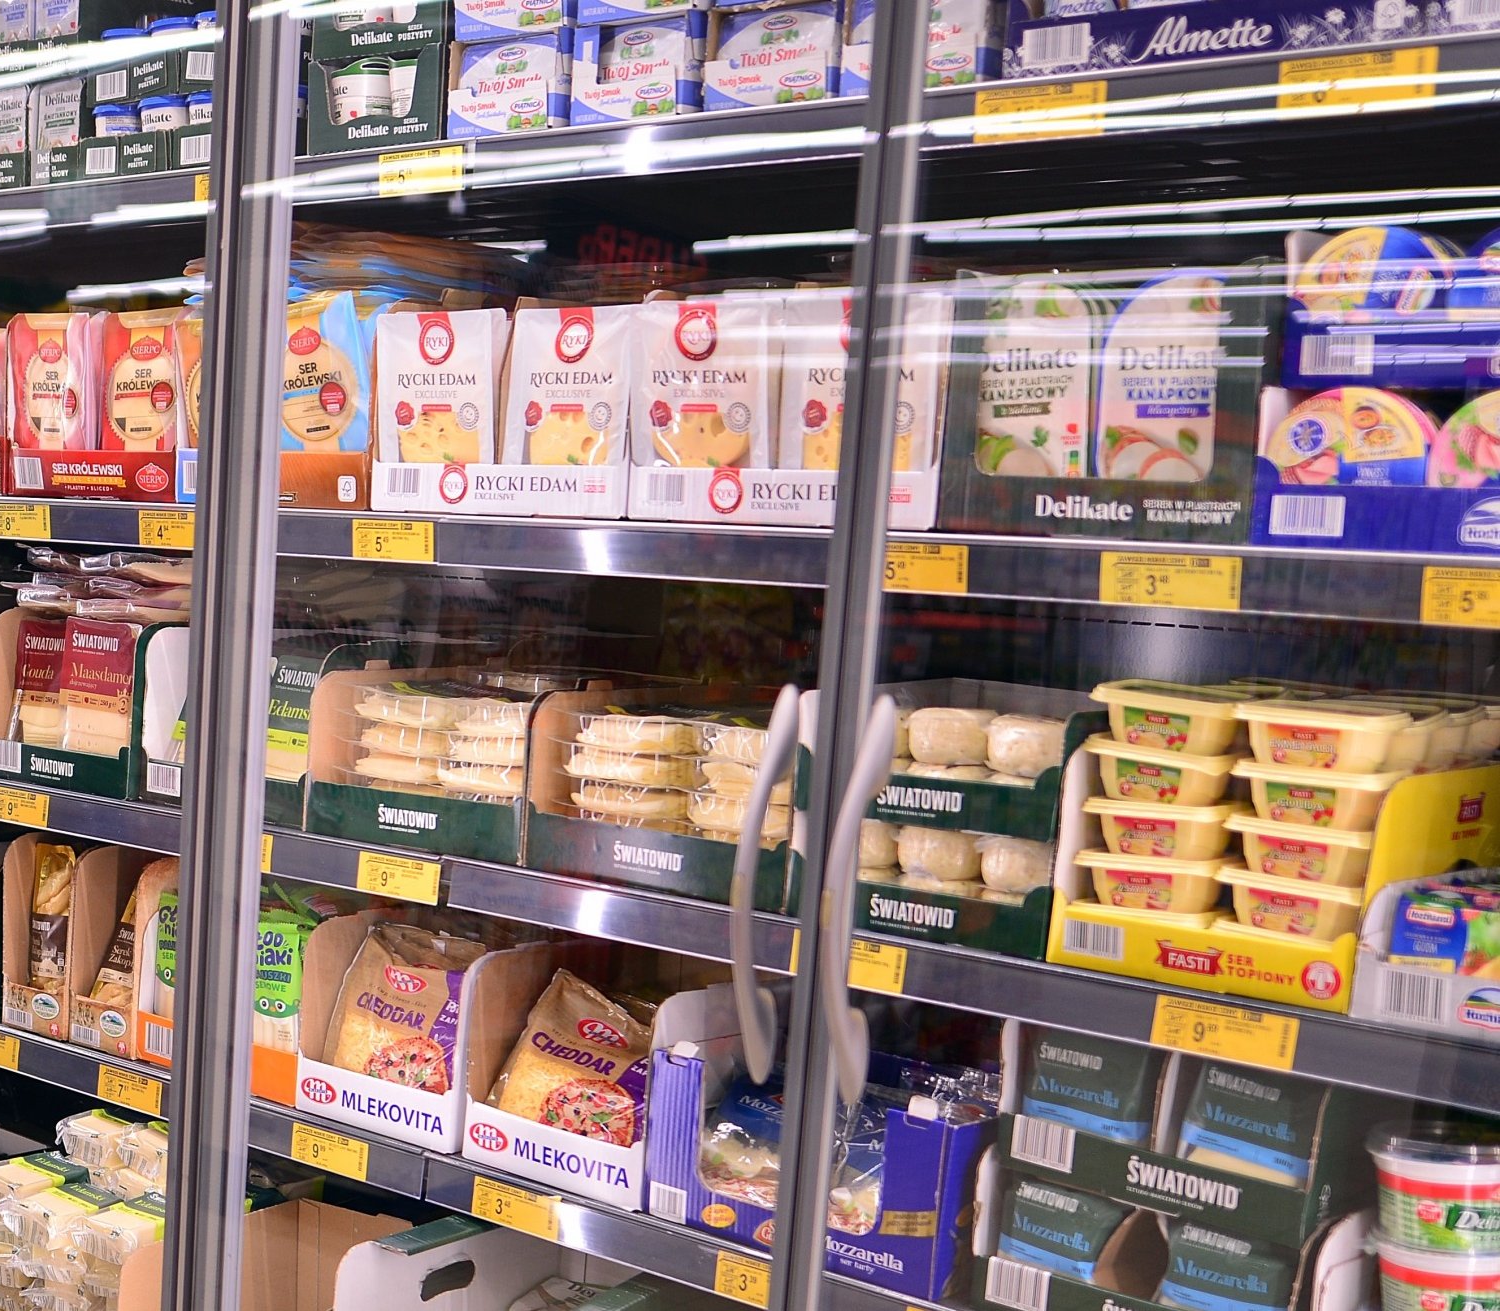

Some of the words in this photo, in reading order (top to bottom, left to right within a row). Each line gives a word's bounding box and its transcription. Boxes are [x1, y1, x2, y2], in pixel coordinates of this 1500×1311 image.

[351, 31, 393, 46] Delikate
[398, 30, 433, 41] PUSZYSTY
[1130, 15, 1273, 64] Almette
[739, 50, 772, 69] Twój
[931, 56, 968, 68] PIĄTNICA
[134, 61, 163, 77] Delikate
[602, 65, 630, 81] Twój
[718, 77, 737, 88] Twój
[738, 75, 761, 85] Smak
[783, 73, 818, 84] PIĄTNICA
[478, 80, 504, 94] Twój
[584, 91, 600, 100] Twój
[602, 88, 620, 97] Smak
[640, 86, 668, 95] PIĄTNICA
[46, 93, 78, 106] Delikate
[514, 101, 540, 110] PIĄTNICA
[461, 104, 476, 113] Twój
[478, 102, 496, 110] Smak
[348, 125, 389, 139] Delikate
[394, 123, 428, 135] PUSZYSTY
[124, 143, 153, 155] Delikate
[37, 153, 67, 164] Delikate
[426, 336, 448, 350] RYKI
[562, 334, 587, 347] RYKI
[132, 346, 160, 354] SIERPC
[45, 371, 58, 380] SER
[135, 369, 152, 378] SER
[298, 362, 318, 375] SER
[397, 373, 435, 387] RYCKI
[439, 373, 476, 386] EDAM
[530, 372, 570, 387] RYCKI
[573, 372, 613, 385] EDAM
[652, 370, 699, 386] RYCKI
[702, 370, 747, 384] EDAM
[415, 389, 458, 399] EXCLUSIVE
[545, 389, 591, 398] EXCLUSIVE
[673, 388, 726, 398] EXCLUSIVE
[52, 464, 69, 474] SER
[69, 461, 122, 475] KRÓLEWSKI
[139, 475, 165, 484] SIERPC
[475, 475, 524, 492] RYCKI
[529, 476, 577, 493] EDAM
[474, 492, 516, 501] EXCLUSIVE
[752, 483, 810, 500] RYCKI
[751, 502, 800, 511] EXCLUSIVE
[1035, 494, 1133, 522] Delikate
[6, 517, 10, 530] 8
[1147, 510, 1235, 525] KANAPKOWY
[157, 525, 163, 540] 4
[376, 537, 382, 552] 5
[885, 562, 895, 580] 5
[1146, 575, 1157, 596] 3
[1460, 591, 1474, 612] 5
[25, 633, 66, 651] ŚWIATOWI
[73, 630, 119, 651] ŚWIATOWID
[71, 662, 133, 685] Maasdamer
[277, 666, 319, 685] ŚWIATOW
[121, 700, 126, 710] 2
[268, 698, 310, 720] Edams
[31, 754, 74, 777] ŚWIATOWID
[877, 786, 964, 813] ŚWIATOWID
[1277, 799, 1324, 810] GOUDA
[8, 802, 12, 815] 9
[378, 804, 438, 830] ŚWIATOWID
[614, 841, 684, 872] ŚWIATOWID
[381, 872, 387, 886] 9
[869, 893, 957, 929] ŚWIATOWID
[1168, 952, 1210, 971] FASTI
[1228, 954, 1253, 966] SER
[357, 992, 425, 1031] CHEDDAR
[1193, 1022, 1204, 1042] 9
[531, 1031, 616, 1076] CHEDDAR
[1039, 1042, 1103, 1070] ŚWIATOWID
[119, 1084, 123, 1097] 7
[1037, 1075, 1119, 1109] Mozzarella
[1207, 1068, 1281, 1101] ŚWIATOWID
[341, 1090, 443, 1135] MLEKOVITA
[1201, 1102, 1296, 1143] Mozzarella
[313, 1144, 318, 1158] 9
[513, 1137, 629, 1188] MLEKOVITA
[1126, 1155, 1243, 1211] ŚWIATOWID
[1016, 1182, 1079, 1213] ŚWIATOWID
[495, 1199, 502, 1214] 3
[1012, 1210, 1091, 1251] Mozzarella
[1181, 1223, 1252, 1256] ŚWIATOWID
[739, 1274, 747, 1291] 3
[1172, 1256, 1269, 1294] Mozzarella
